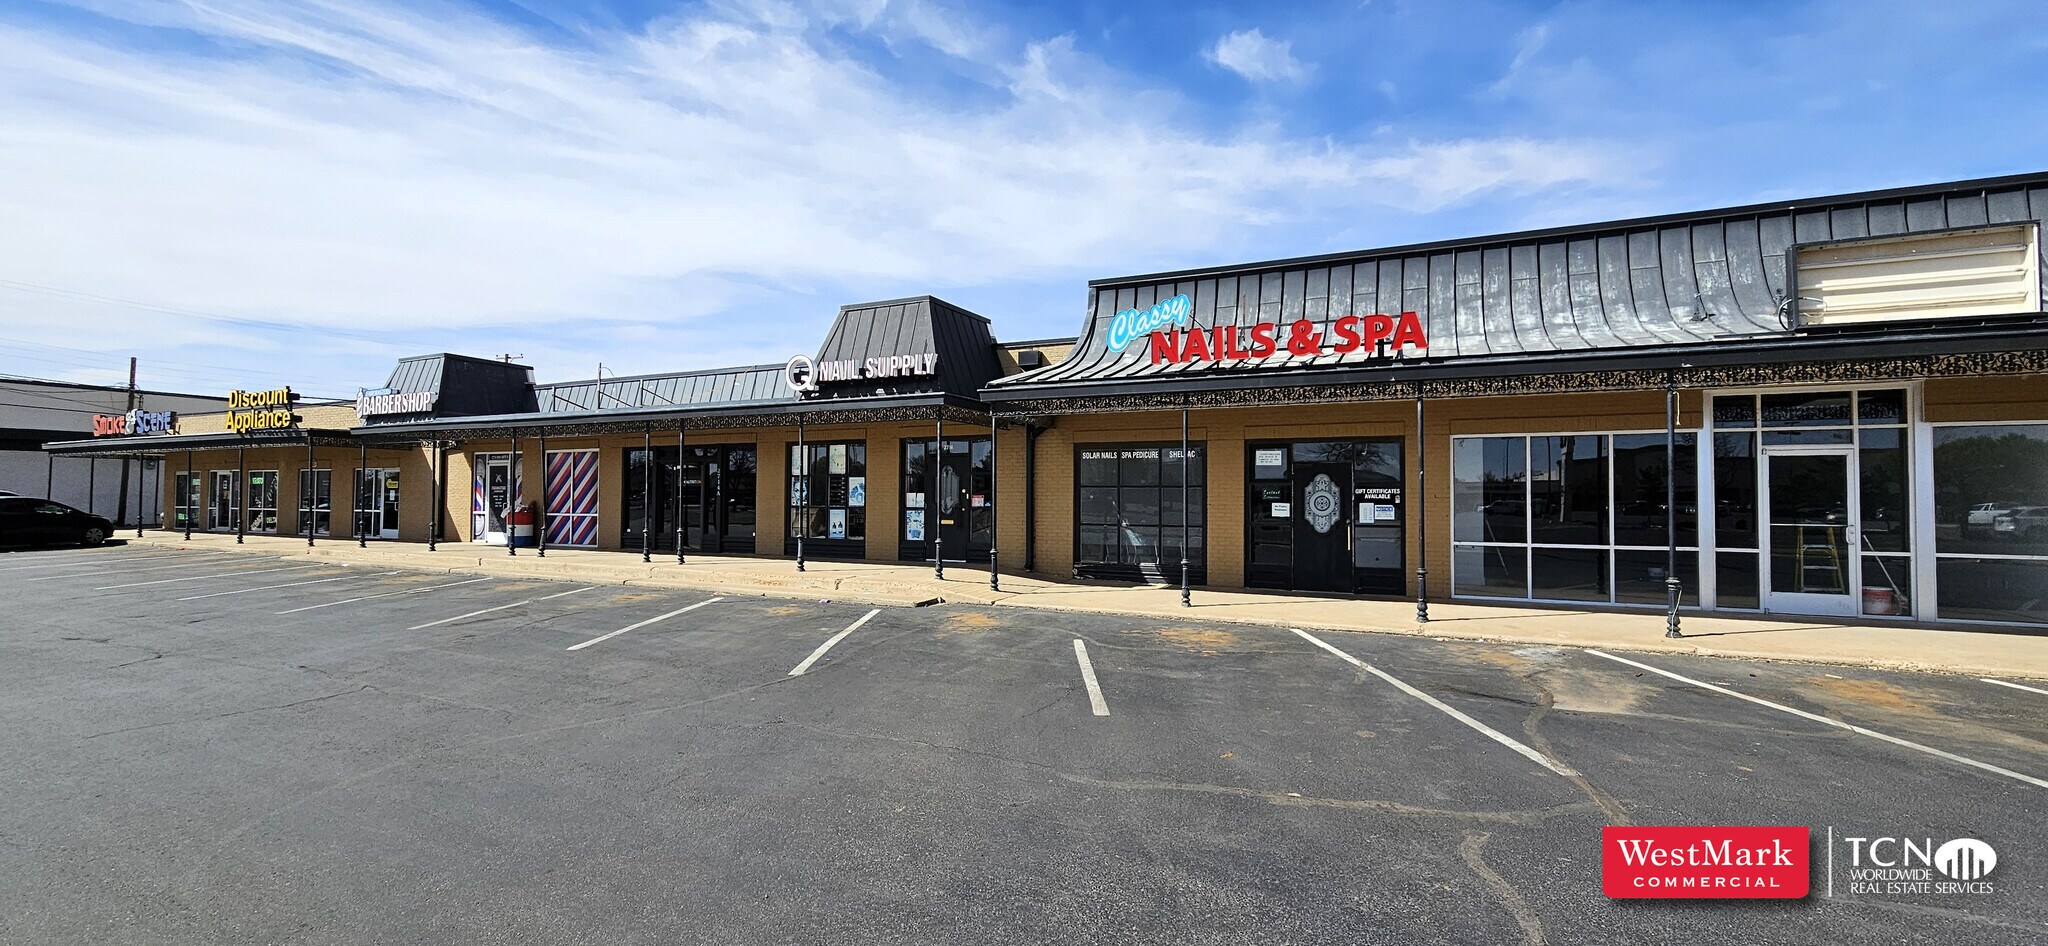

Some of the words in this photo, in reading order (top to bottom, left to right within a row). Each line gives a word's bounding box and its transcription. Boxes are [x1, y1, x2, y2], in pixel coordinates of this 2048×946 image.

[1108, 294, 1190, 351] Classy
[1150, 322, 1277, 364] NAILS
[1286, 319, 1323, 356] &
[1333, 311, 1429, 354] SPA
[785, 354, 817, 391] Q
[819, 359, 862, 382] NAIL
[865, 353, 936, 379] SUPPLY
[228, 387, 288, 408] Discount
[225, 409, 291, 434] Appliance
[1101, 451, 1118, 459] NAILS
[1121, 451, 1132, 459] SPA
[1132, 450, 1159, 459] PEDICURE
[1169, 450, 1196, 458] SHELAC
